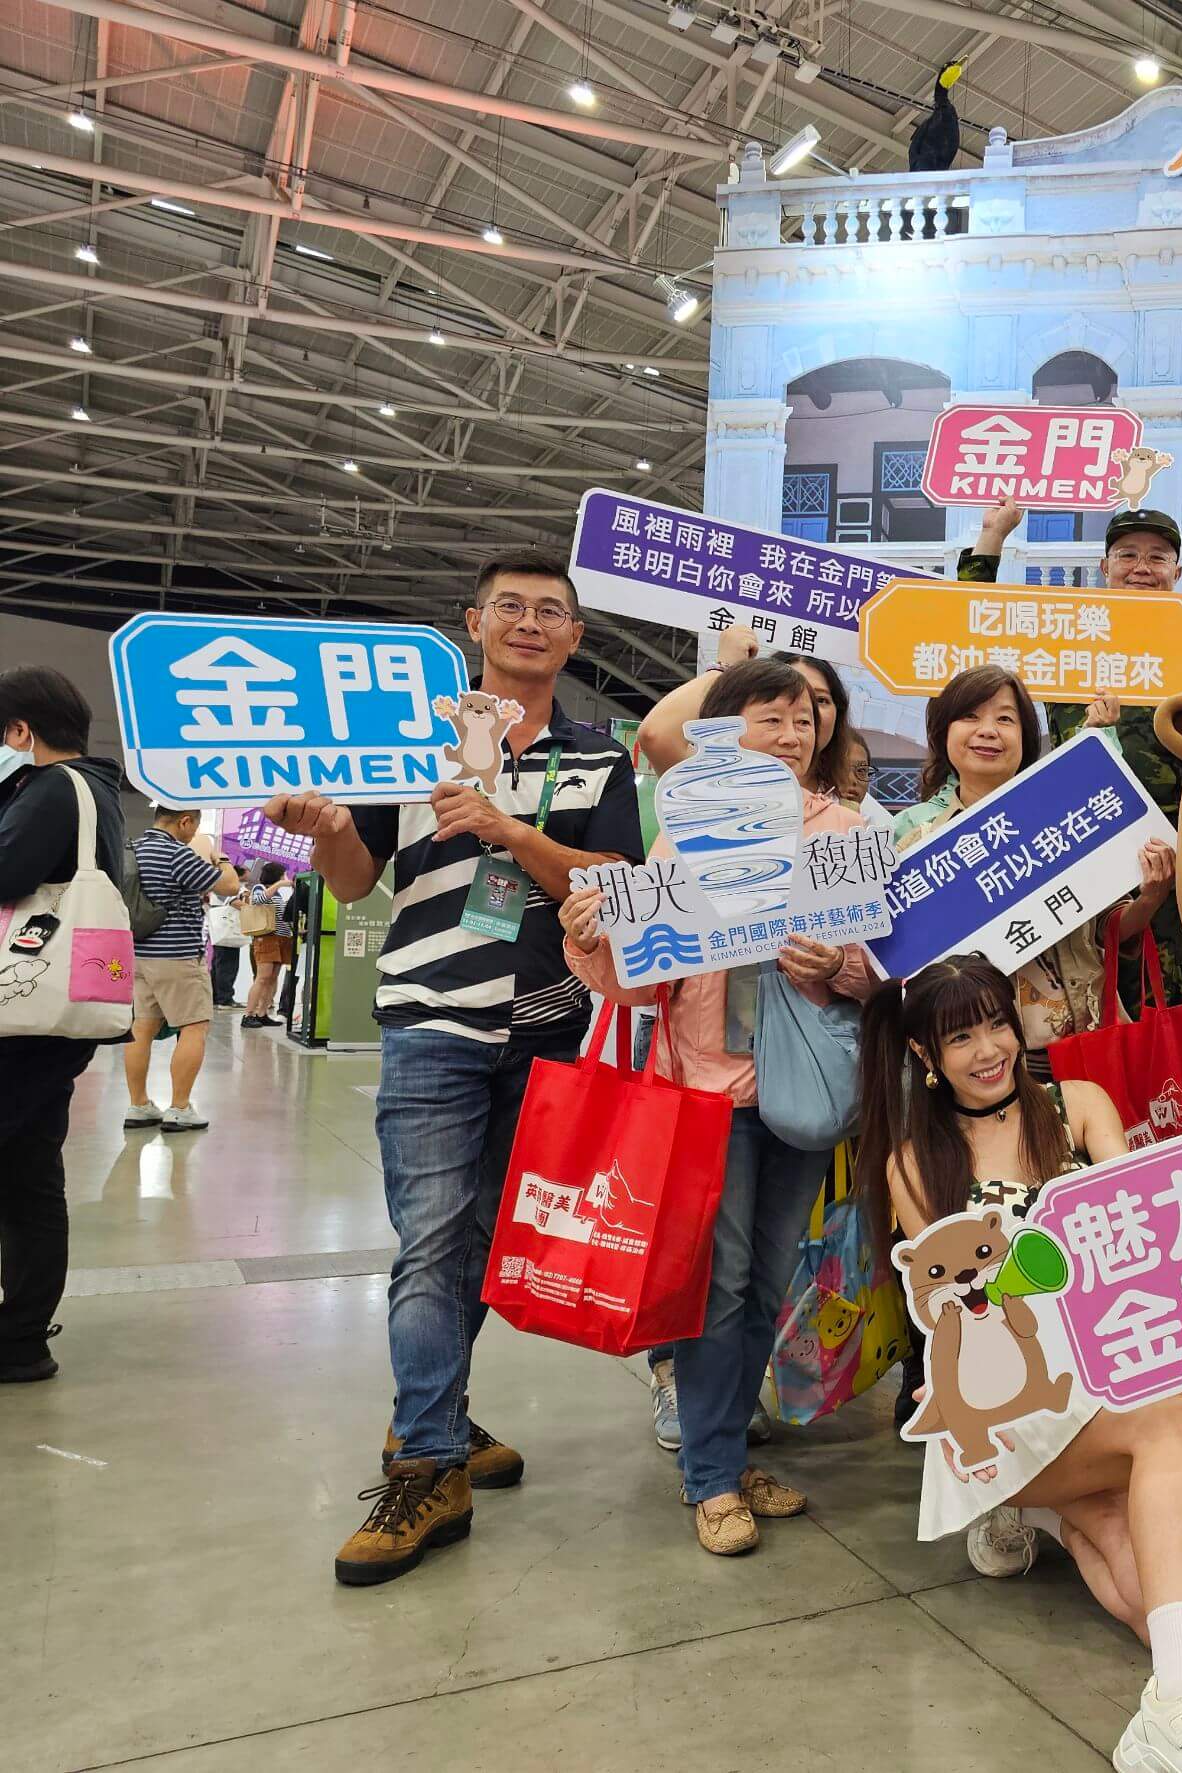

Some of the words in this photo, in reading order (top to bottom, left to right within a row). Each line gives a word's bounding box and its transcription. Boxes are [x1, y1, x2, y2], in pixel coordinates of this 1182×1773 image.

[954, 414, 1115, 478] 金門
[950, 475, 1104, 500] KINMEN
[611, 505, 735, 559] 風裡雨裡
[612, 542, 793, 607] 我明白你會來
[707, 606, 818, 653] 金門館
[967, 599, 1111, 642] 吃喝玩樂
[168, 635, 434, 742] 金門
[185, 752, 439, 790] KINMEN
[803, 829, 897, 891] 馥郁
[975, 786, 1124, 903] 所以我在等
[708, 901, 882, 950] 金門國際海洋藝術季
[710, 947, 752, 961] KINMEN
[816, 929, 860, 941] FESTIVAL
[863, 921, 885, 931] 2024
[1004, 885, 1084, 954] 金門
